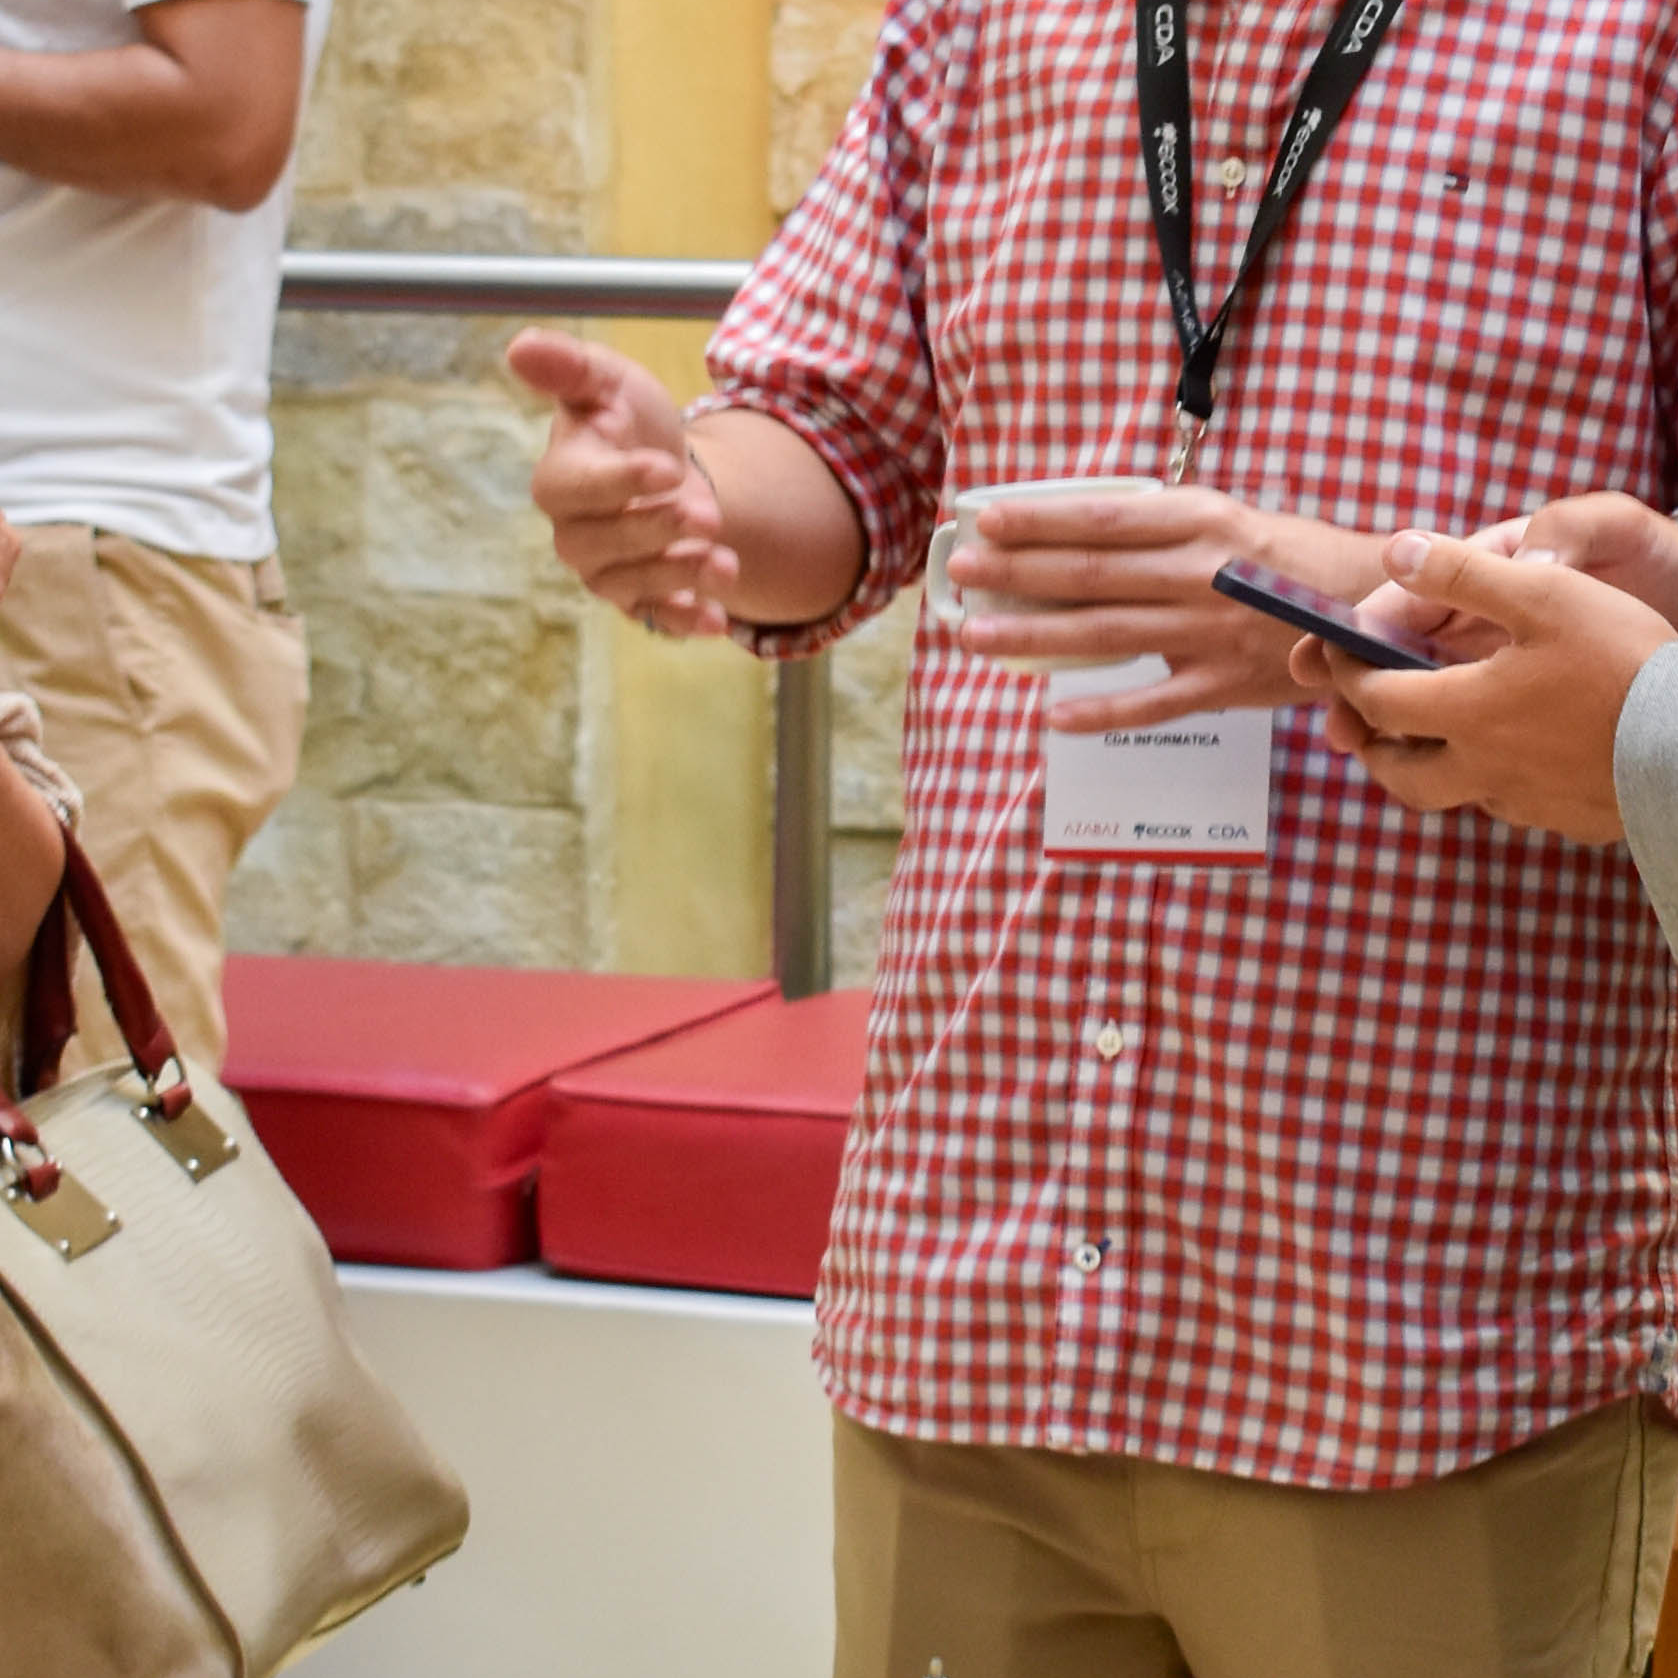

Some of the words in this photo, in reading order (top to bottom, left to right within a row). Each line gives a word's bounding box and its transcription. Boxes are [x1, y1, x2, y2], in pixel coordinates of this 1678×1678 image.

[1155, 4, 1175, 66] CDA
[1104, 731, 1130, 746] CDA
[1207, 824, 1249, 840] CDA
